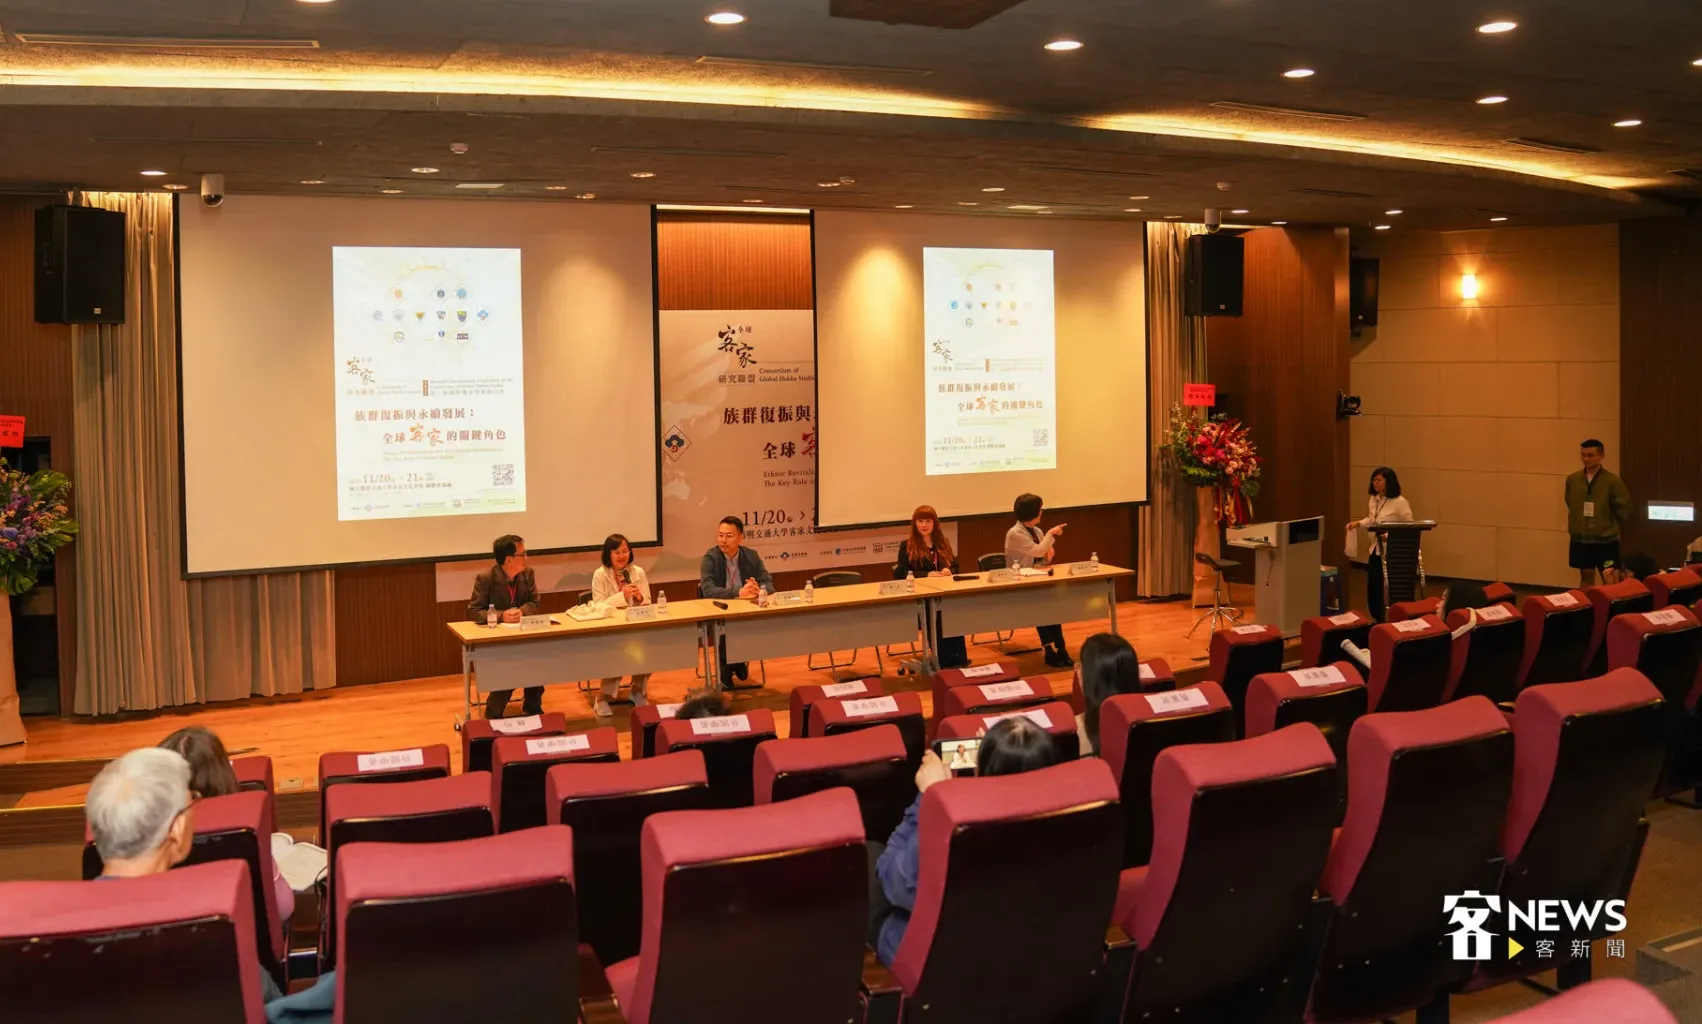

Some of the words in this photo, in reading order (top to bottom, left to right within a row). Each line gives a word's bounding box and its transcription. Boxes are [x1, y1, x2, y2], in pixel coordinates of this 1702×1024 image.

[718, 325, 758, 368] 客家
[718, 374, 756, 384] 研究聯盟
[723, 405, 815, 425] 族群復振與
[382, 423, 507, 446] 全球客家的關鍵角色
[364, 474, 391, 484] 11/20
[778, 479, 790, 488] Key
